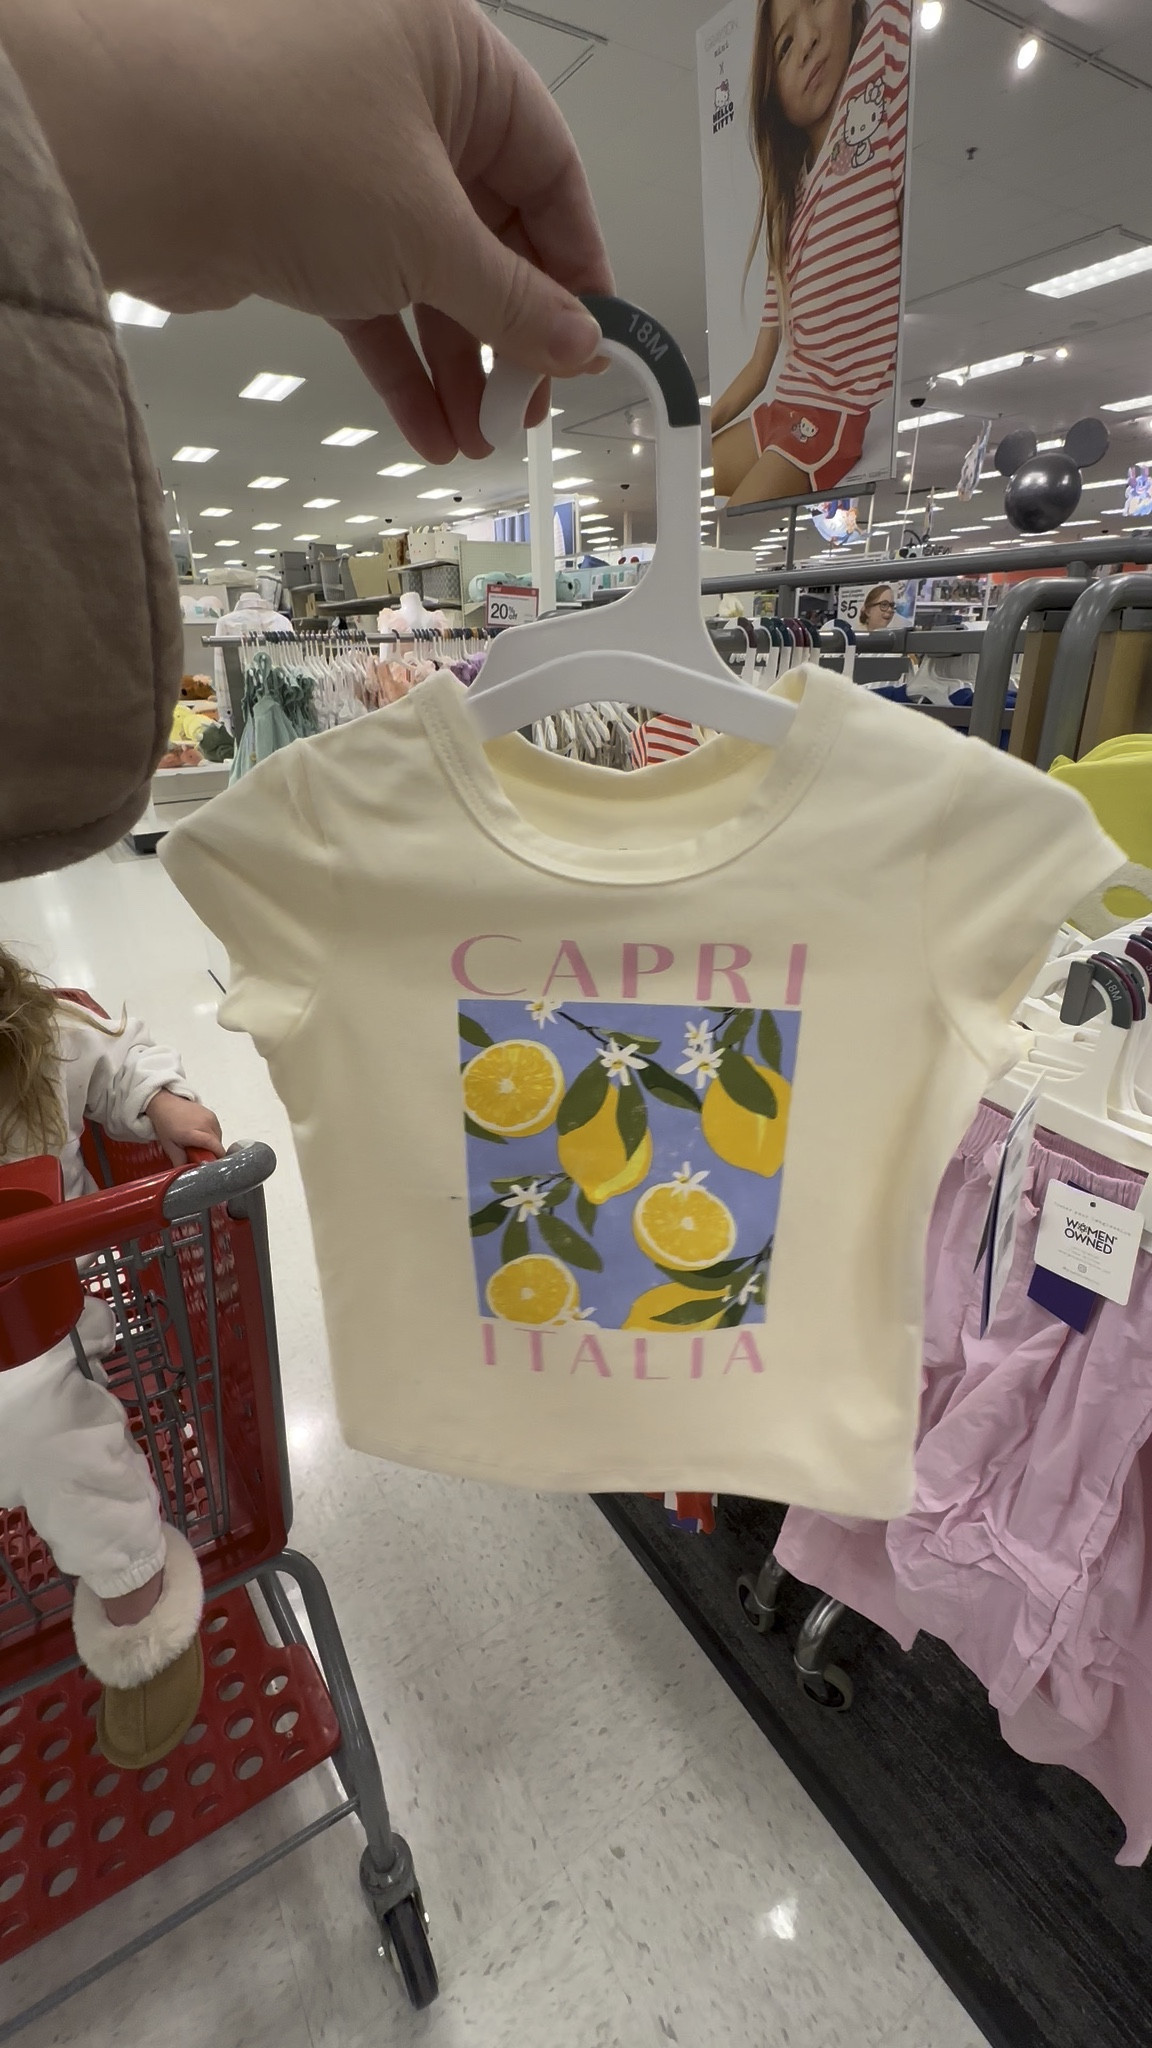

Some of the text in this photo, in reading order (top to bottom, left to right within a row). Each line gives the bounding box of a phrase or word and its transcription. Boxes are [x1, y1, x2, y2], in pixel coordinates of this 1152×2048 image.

[712, 101, 734, 124] HELLO
[712, 110, 735, 134] KITTY
[628, 313, 669, 361] 18M
[840, 600, 858, 619] $5
[451, 934, 808, 1005] CAPRI
[1104, 980, 1122, 1002] 18M
[1064, 1228, 1113, 1255] OWNED
[481, 1323, 765, 1380] ITALIA
